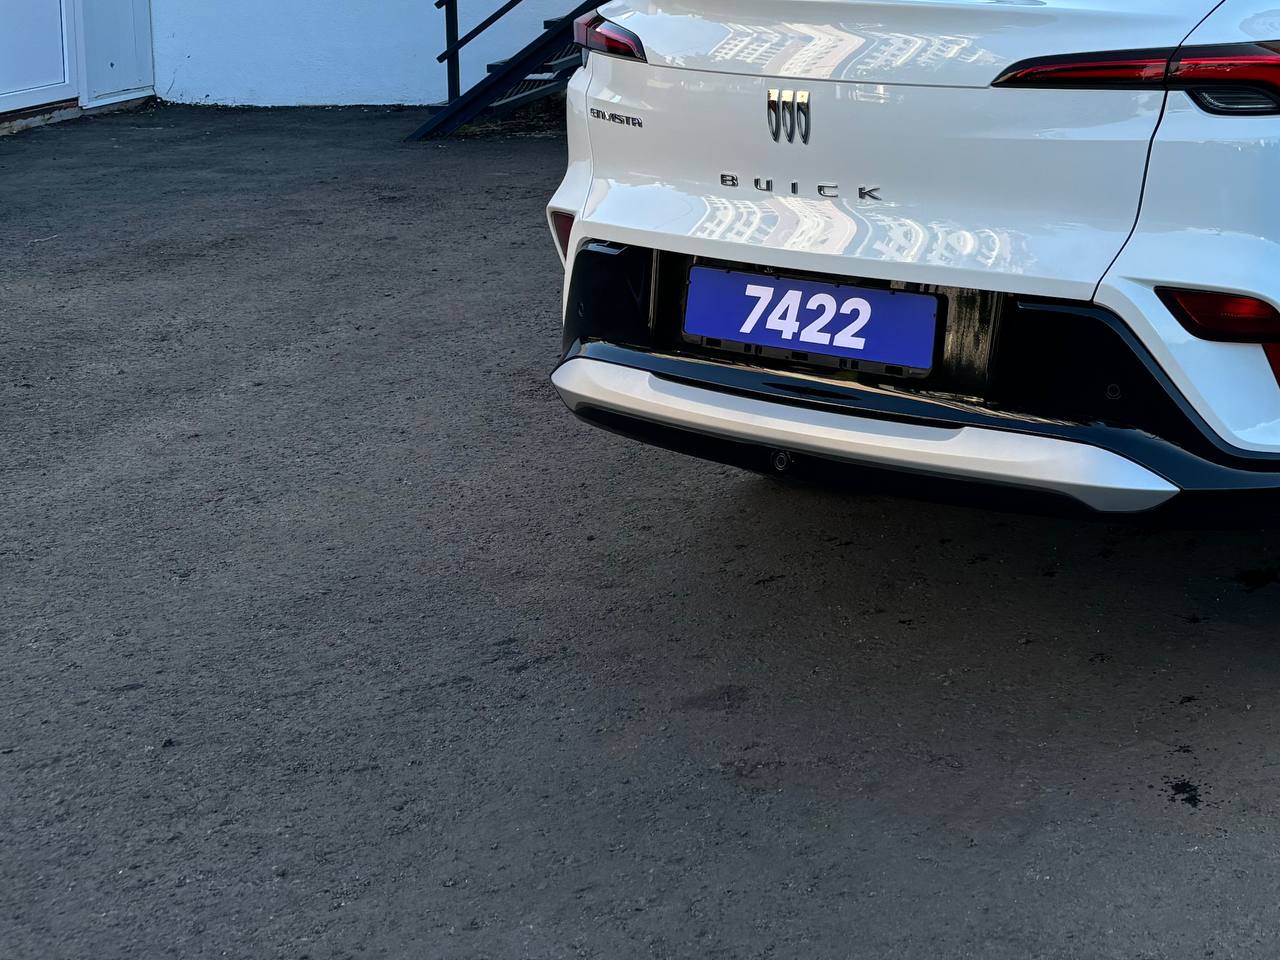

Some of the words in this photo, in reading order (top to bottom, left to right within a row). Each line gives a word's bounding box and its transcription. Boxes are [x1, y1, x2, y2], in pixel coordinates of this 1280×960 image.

[590, 107, 643, 128] ENVISTA
[720, 173, 882, 200] BUICK
[739, 283, 872, 350] 7422
